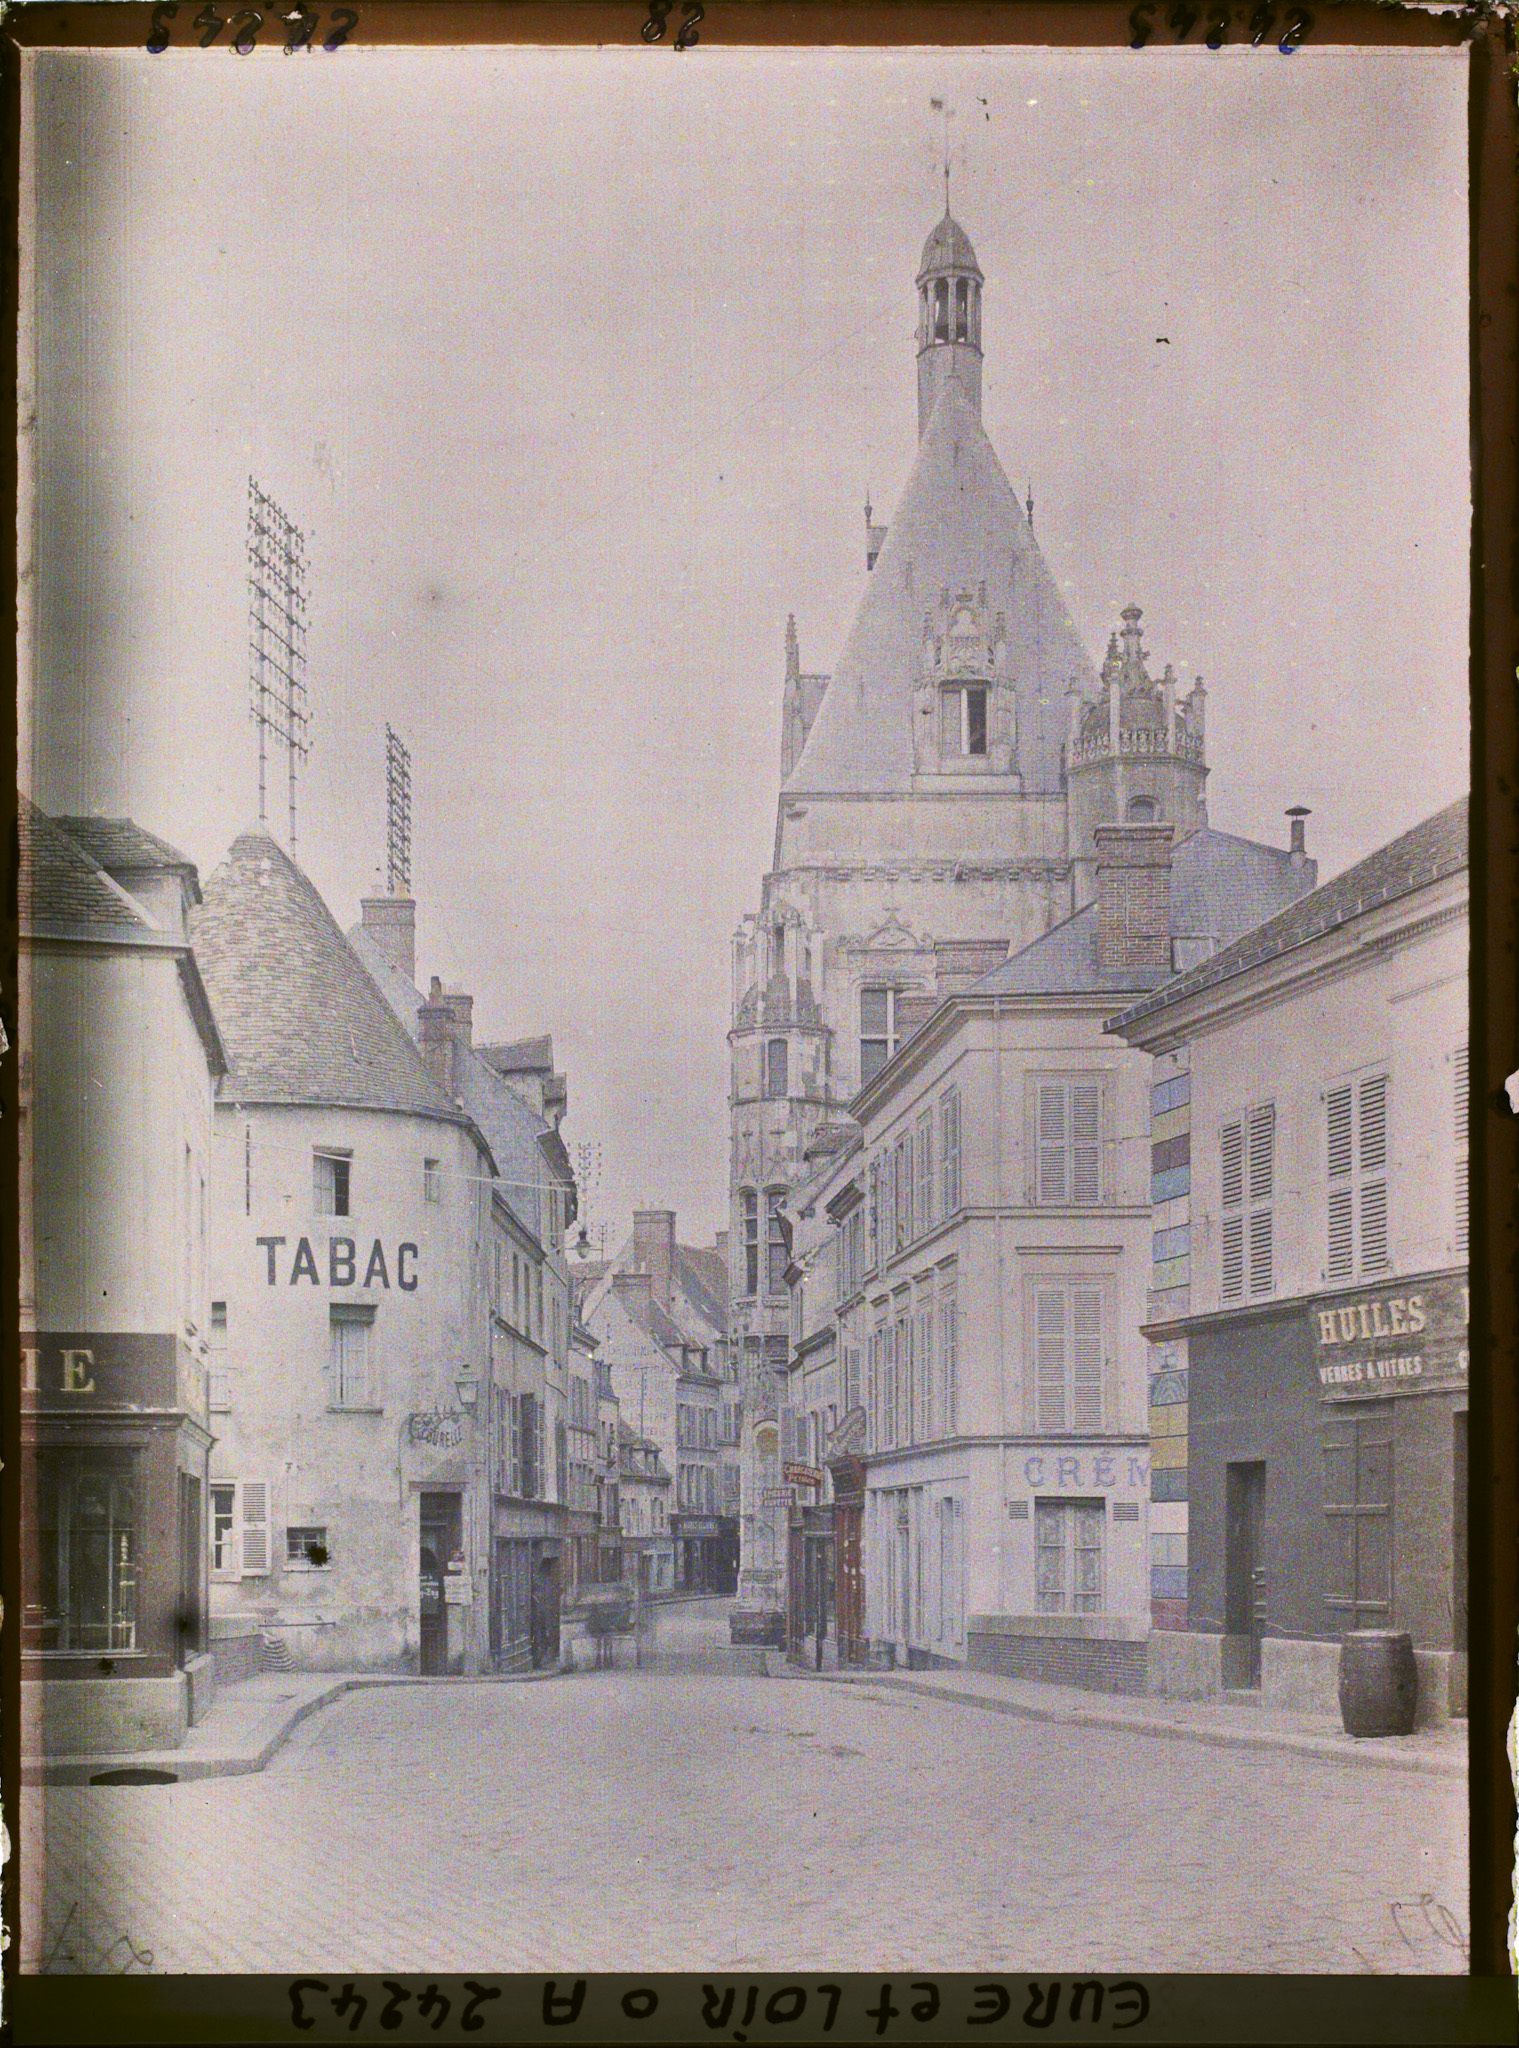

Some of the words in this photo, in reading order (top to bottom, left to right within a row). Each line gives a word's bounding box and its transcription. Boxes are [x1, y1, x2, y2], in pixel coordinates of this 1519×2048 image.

[256, 1236, 419, 1291] TABAC
[1318, 1295, 1427, 1345] HUILES
[1319, 1362, 1363, 1385] VERRES
[1377, 1355, 1424, 1378] VITRES
